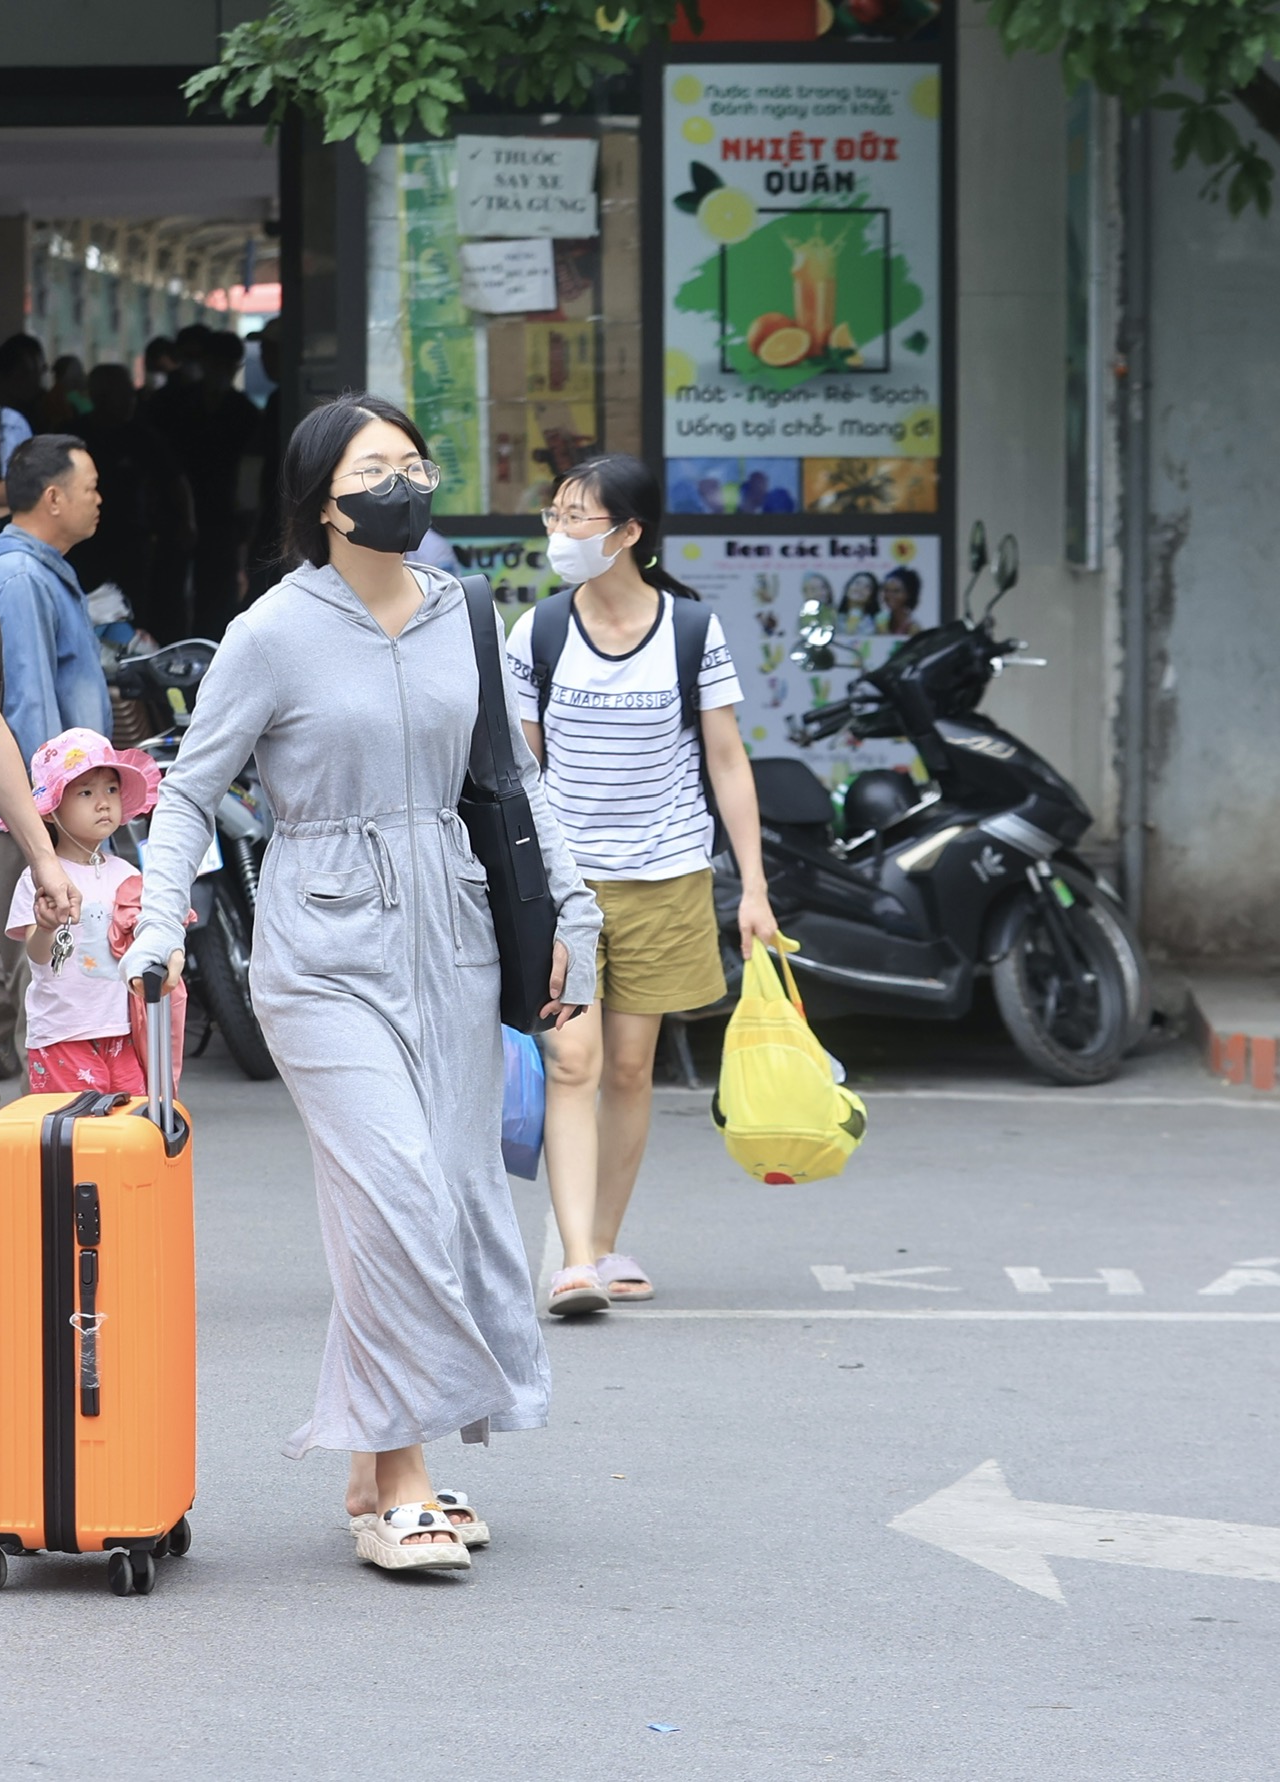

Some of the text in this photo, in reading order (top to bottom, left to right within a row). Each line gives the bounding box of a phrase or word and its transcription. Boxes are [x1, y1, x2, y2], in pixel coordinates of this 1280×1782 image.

[721, 130, 826, 168] NHIỆT
[764, 164, 855, 195] QUÁN
[677, 414, 736, 440] Uống
[572, 689, 610, 707] MADE
